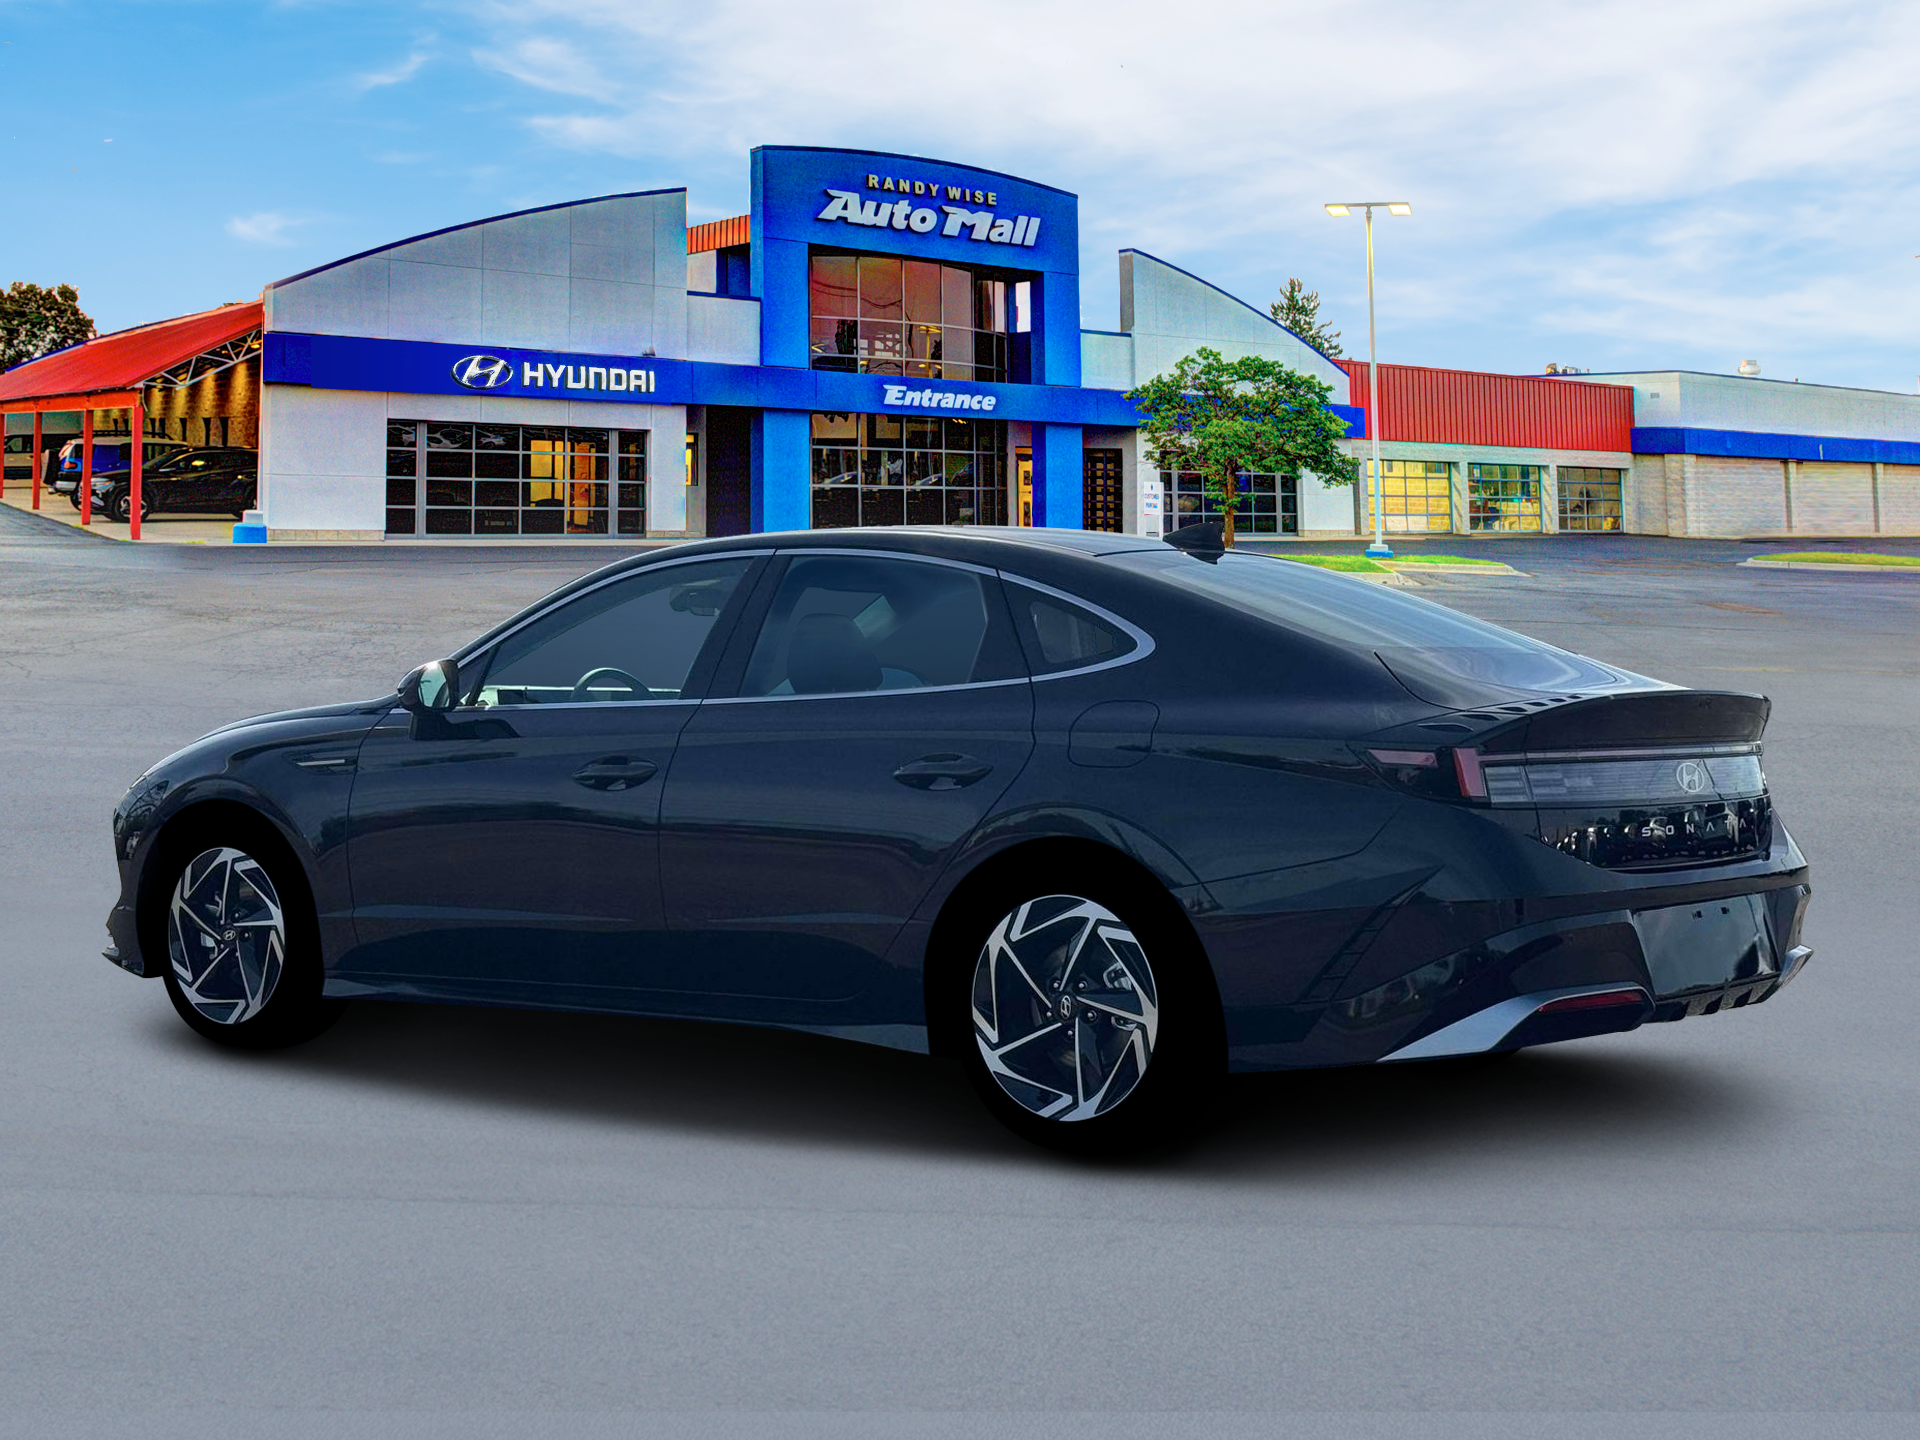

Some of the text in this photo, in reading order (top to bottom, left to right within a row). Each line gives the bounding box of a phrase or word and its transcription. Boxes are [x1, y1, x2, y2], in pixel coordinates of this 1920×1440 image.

[866, 174, 997, 206] RANDY WISE
[817, 188, 1041, 247] Auto Mall
[521, 361, 656, 394] HYUNDAI
[883, 384, 996, 411] Entrance
[1641, 818, 1747, 837] SONATA
